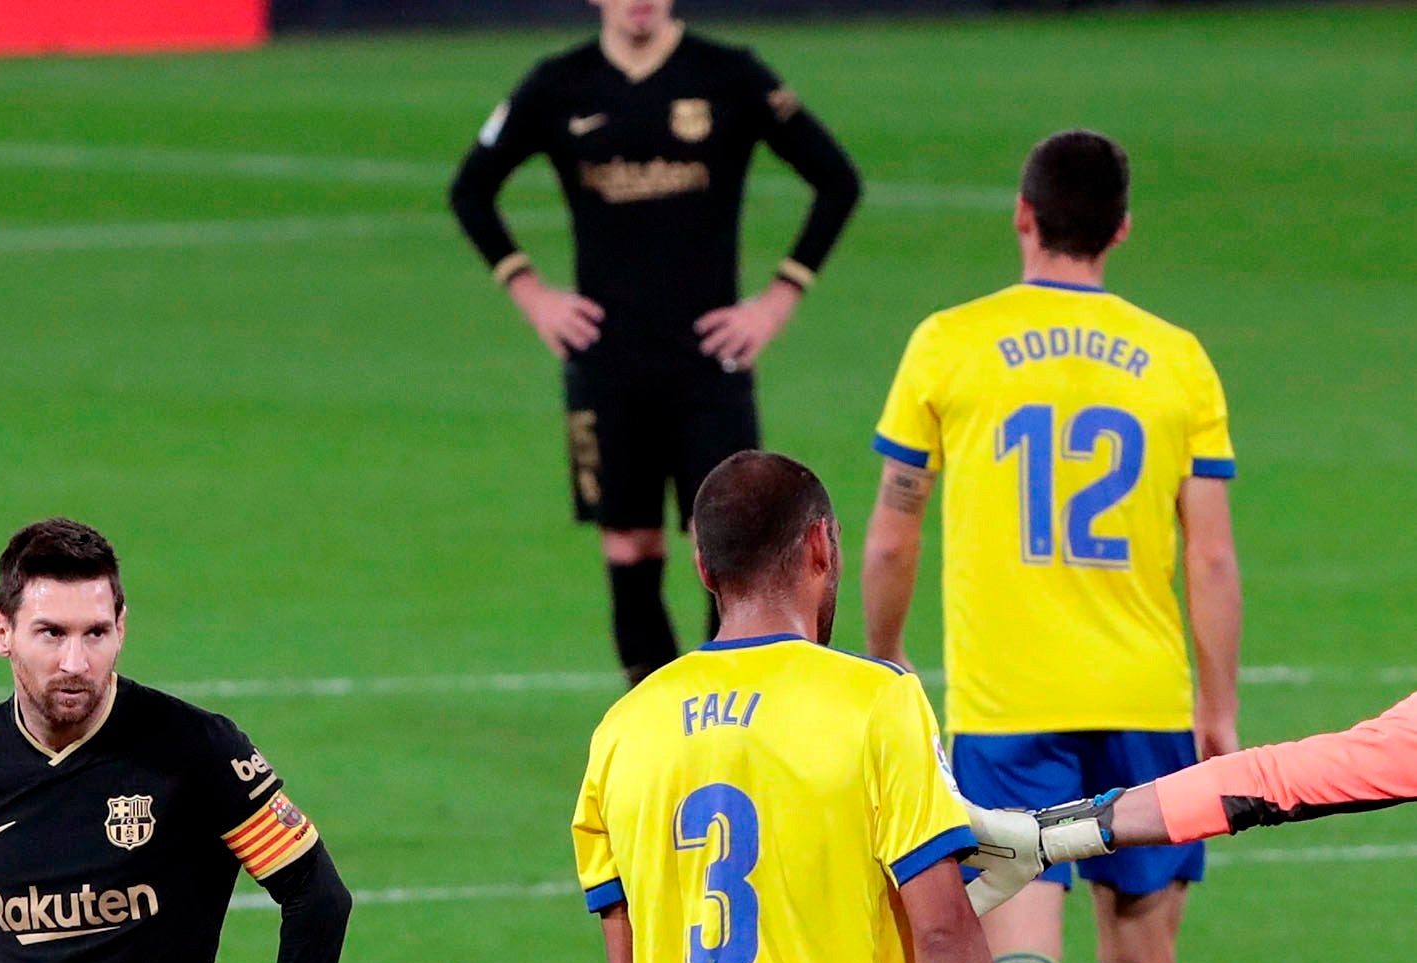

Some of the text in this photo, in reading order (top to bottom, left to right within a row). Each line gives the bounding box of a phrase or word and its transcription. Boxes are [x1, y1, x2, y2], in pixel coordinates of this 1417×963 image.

[997, 327, 1149, 378] BODIGER
[995, 404, 1145, 570] 12
[682, 691, 762, 736] FALI
